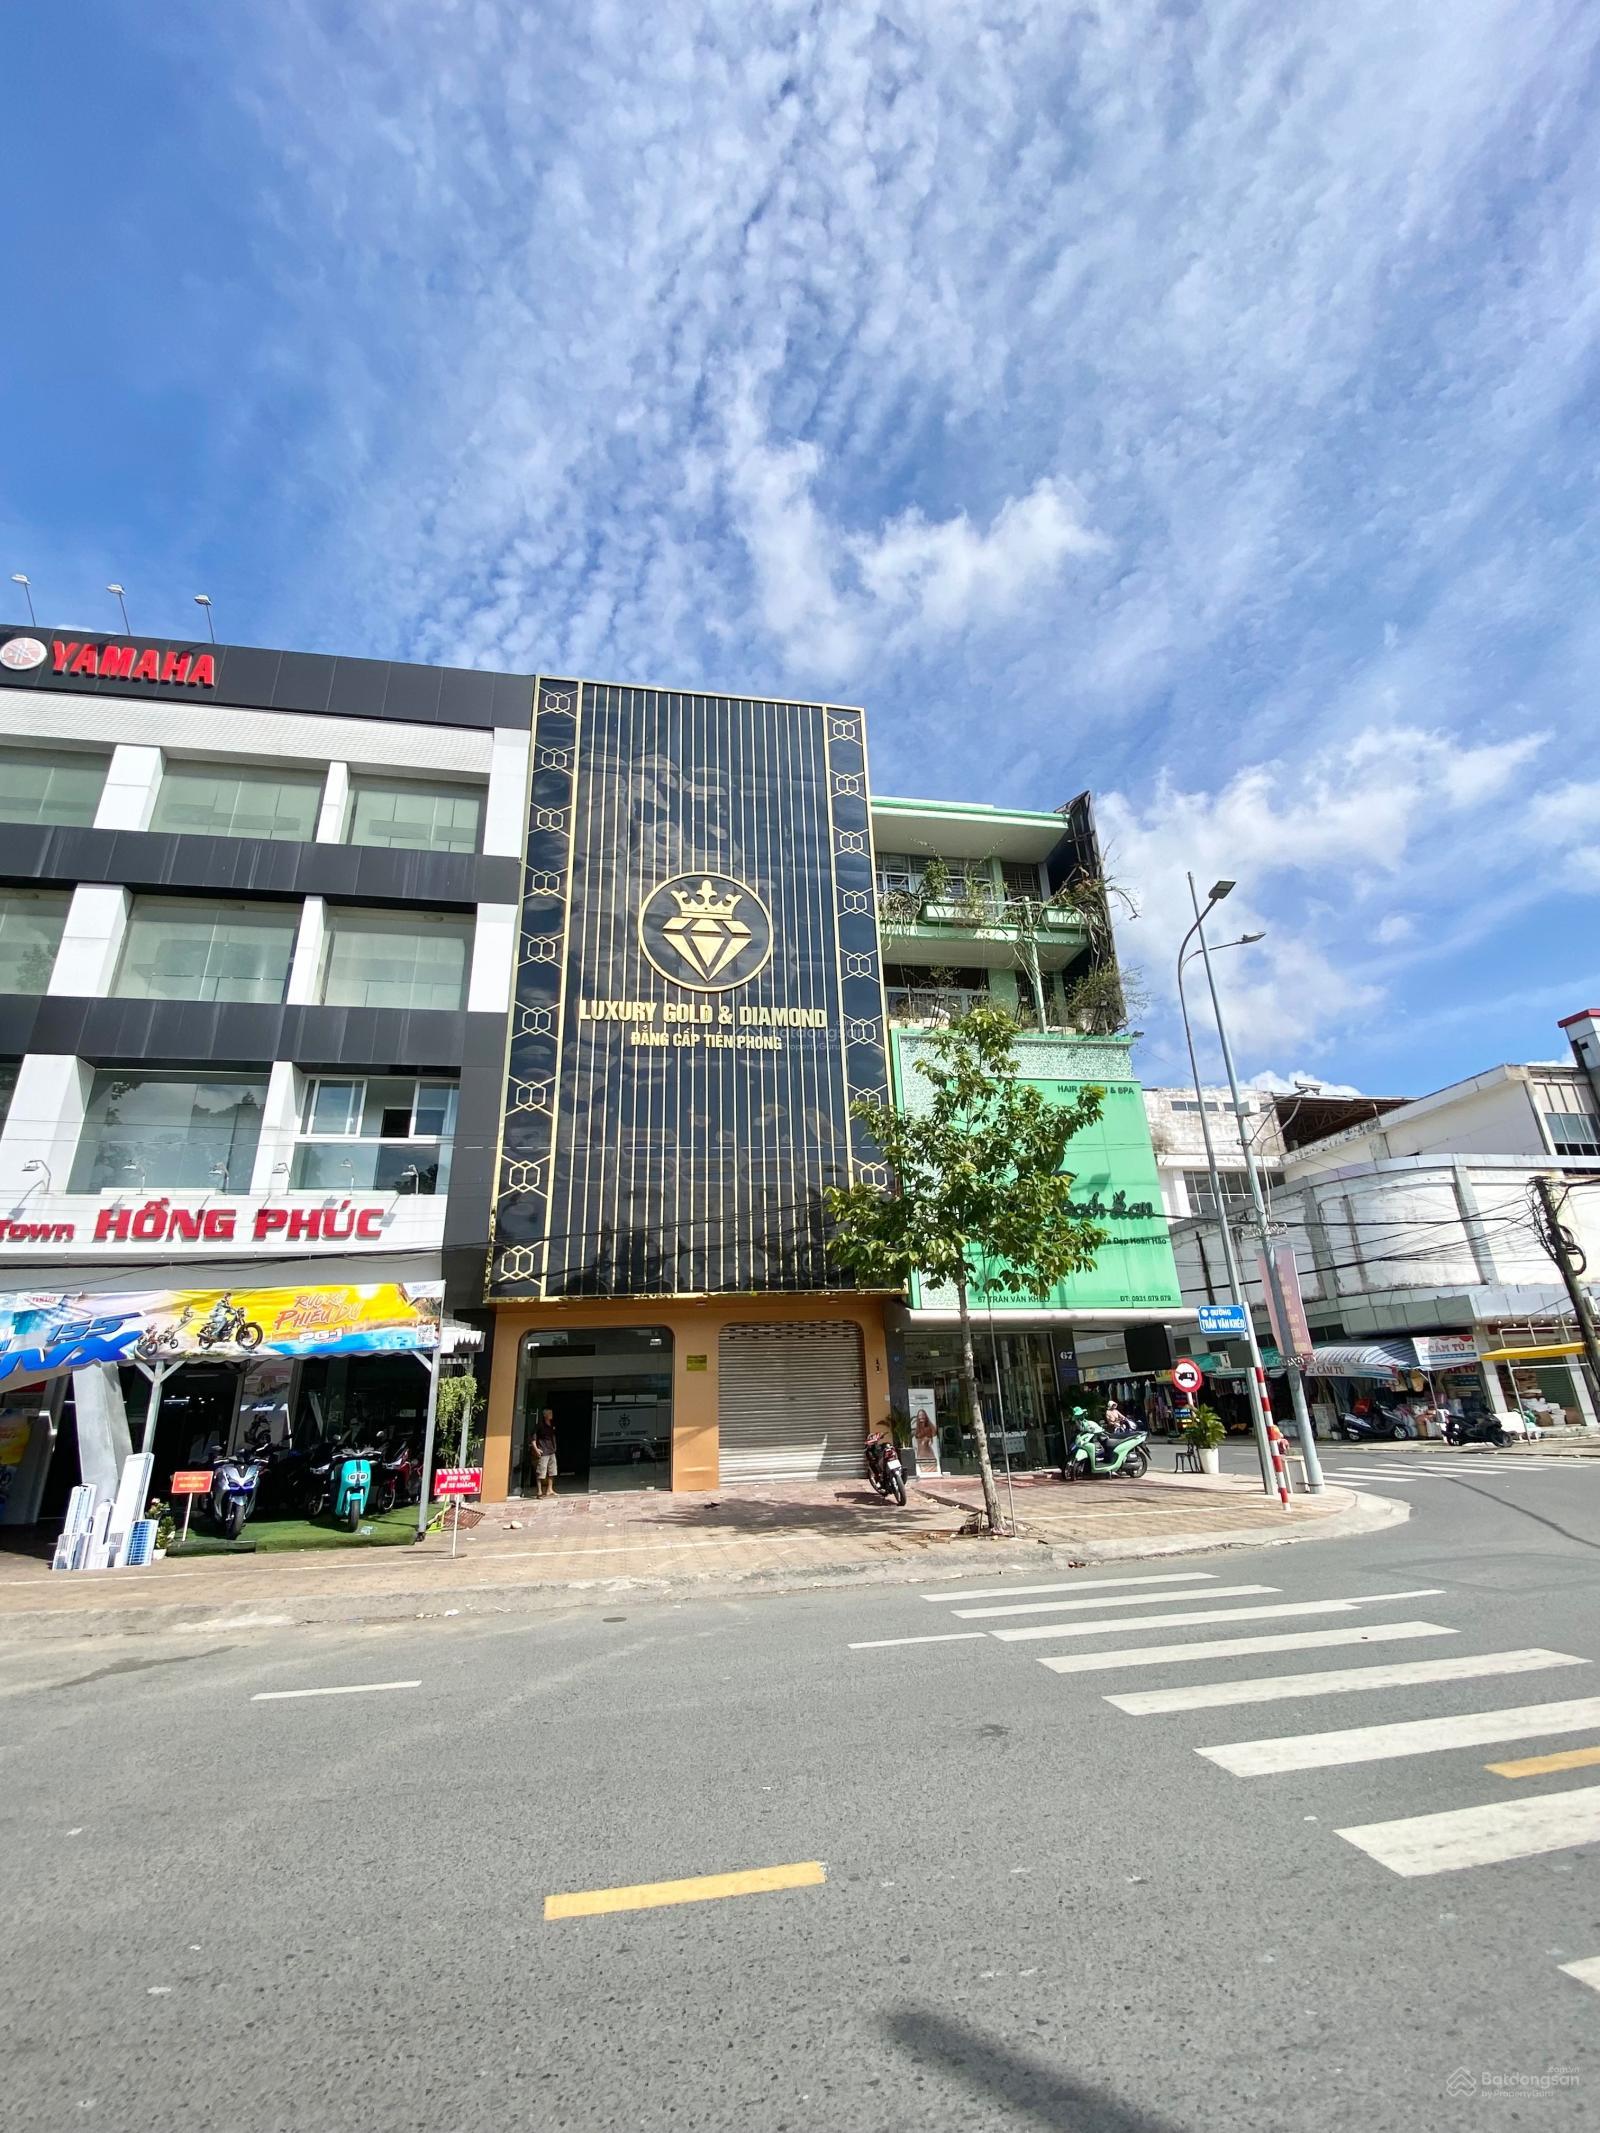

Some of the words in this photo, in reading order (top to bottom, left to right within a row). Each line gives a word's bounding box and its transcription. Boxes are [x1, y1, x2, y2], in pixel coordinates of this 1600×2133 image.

[52, 640, 215, 688] YAMAHA
[580, 1000, 657, 1021] LUXURY
[663, 1003, 713, 1024] GOLD
[718, 1005, 733, 1025] &
[740, 1006, 827, 1028] DIAMOND
[673, 1028, 700, 1047] CẤP
[737, 1035, 782, 1050] PHONG
[1057, 1085, 1078, 1093] HAIR
[1118, 1087, 1135, 1095] SPA
[252, 1200, 385, 1241] PHÚC
[978, 1295, 986, 1303] 67
[1060, 1351, 1074, 1360] 67
